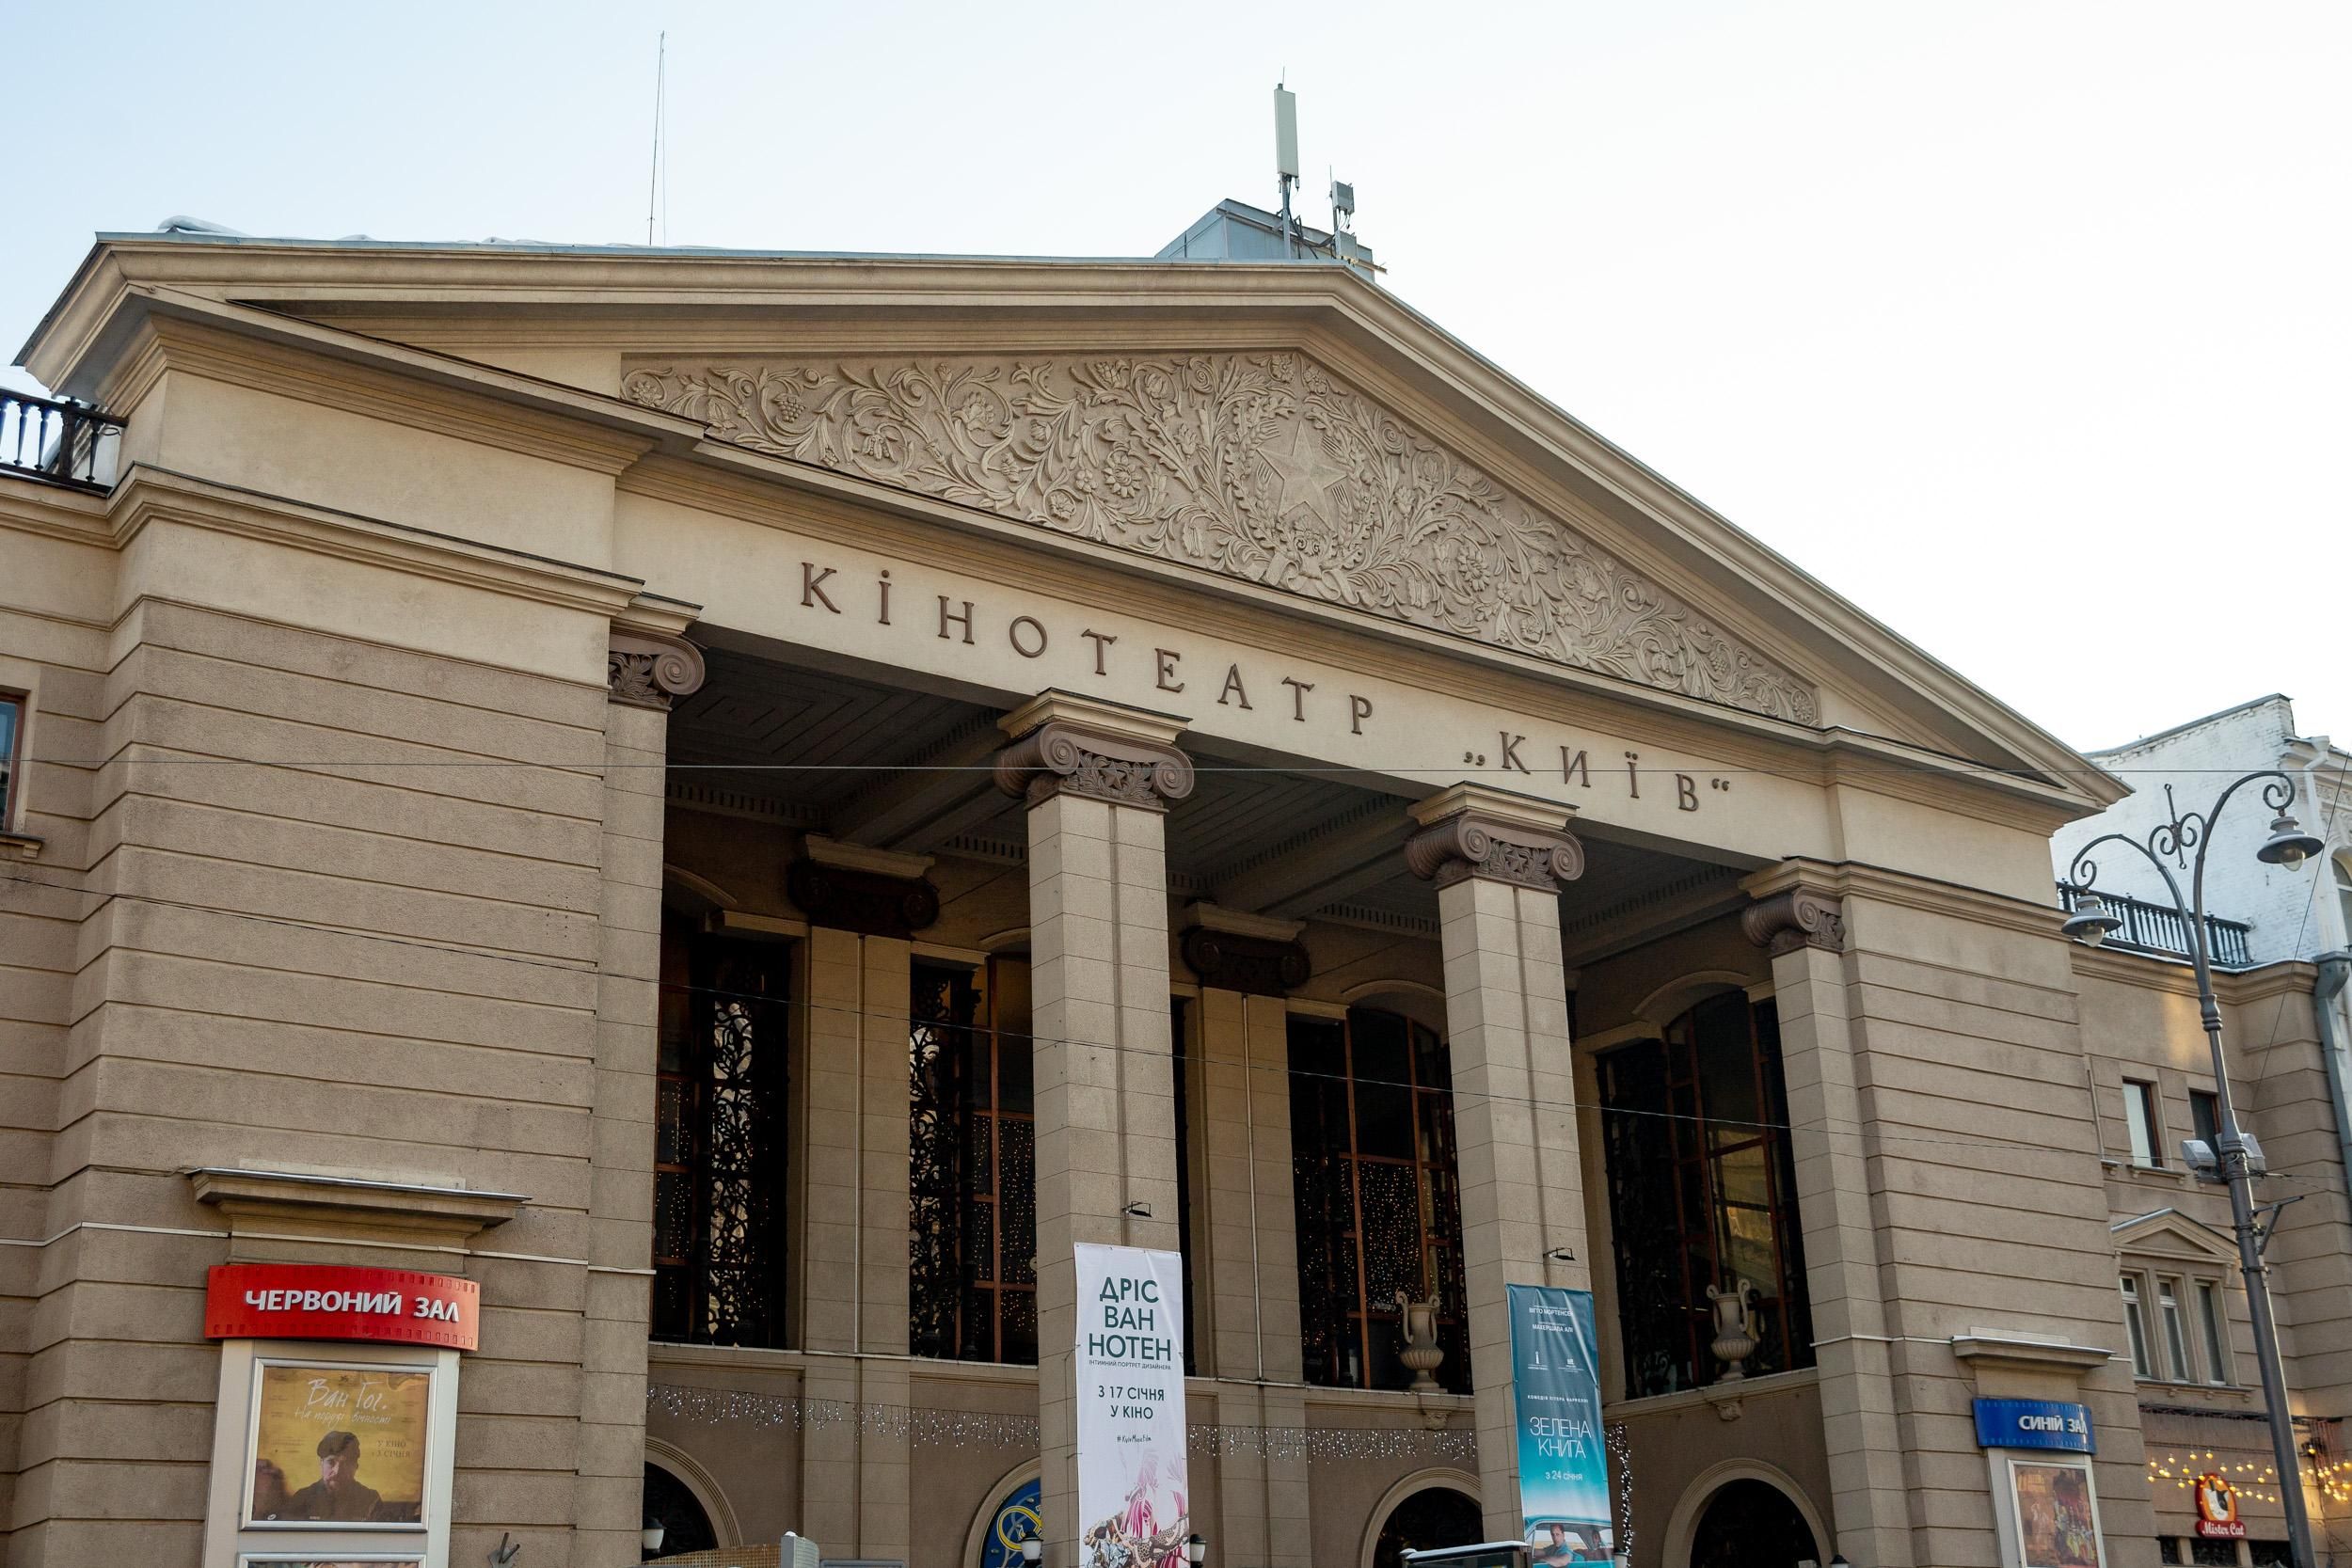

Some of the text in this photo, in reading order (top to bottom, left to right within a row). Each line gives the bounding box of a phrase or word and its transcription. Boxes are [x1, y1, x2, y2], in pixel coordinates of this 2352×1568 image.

[800, 560, 1374, 736] КІНОТЕАТР
[1099, 1276, 1159, 1303] ДРІС
[245, 1290, 459, 1323] ЧЕРВОНИЙ ЗАЛ
[1104, 1305, 1154, 1331] ВАН
[1089, 1333, 1171, 1361] НОТЕН
[308, 1378, 349, 1408] Ван
[1109, 1386, 1123, 1399] 17
[1127, 1386, 1165, 1402] СІЧНЯ
[1110, 1404, 1153, 1419] У КІНО
[1530, 1416, 1592, 1438] ЗЕЛЕНА
[2018, 1415, 2089, 1434] СИНІЙ ЗАЛ
[1538, 1438, 1586, 1459] КНИГА
[1551, 1470, 1562, 1480] 24
[2202, 1521, 2245, 1536] Mister Cat
